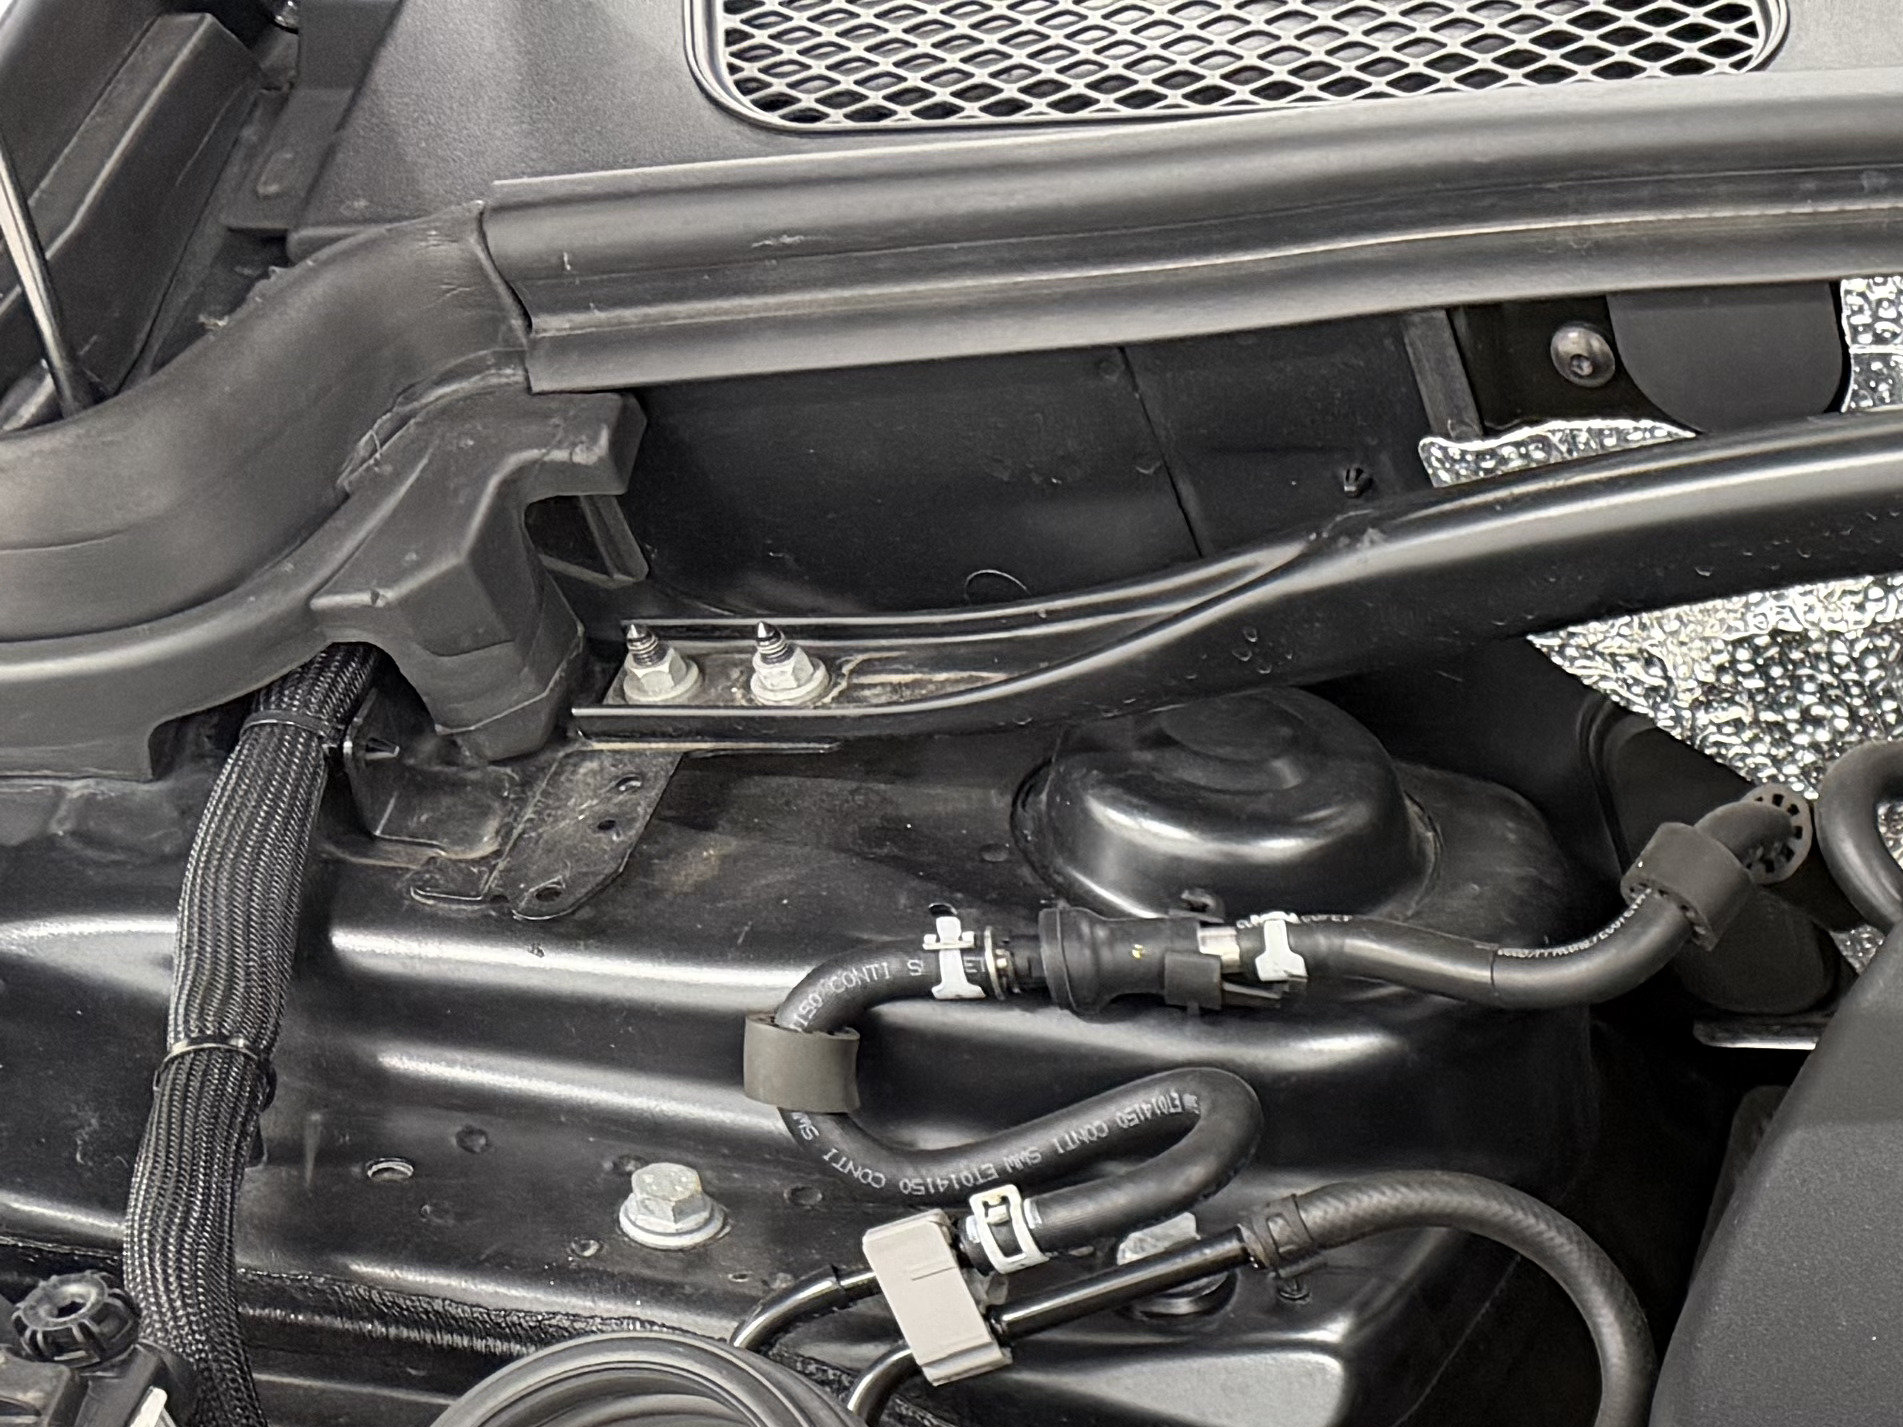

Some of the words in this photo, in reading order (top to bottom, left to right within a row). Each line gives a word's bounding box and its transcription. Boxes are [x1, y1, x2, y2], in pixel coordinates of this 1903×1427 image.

[829, 961, 891, 994] CONTI
[1052, 1120, 1110, 1154] CONTI
[822, 1148, 886, 1189] CONTI
[900, 1163, 999, 1195] ET014150
